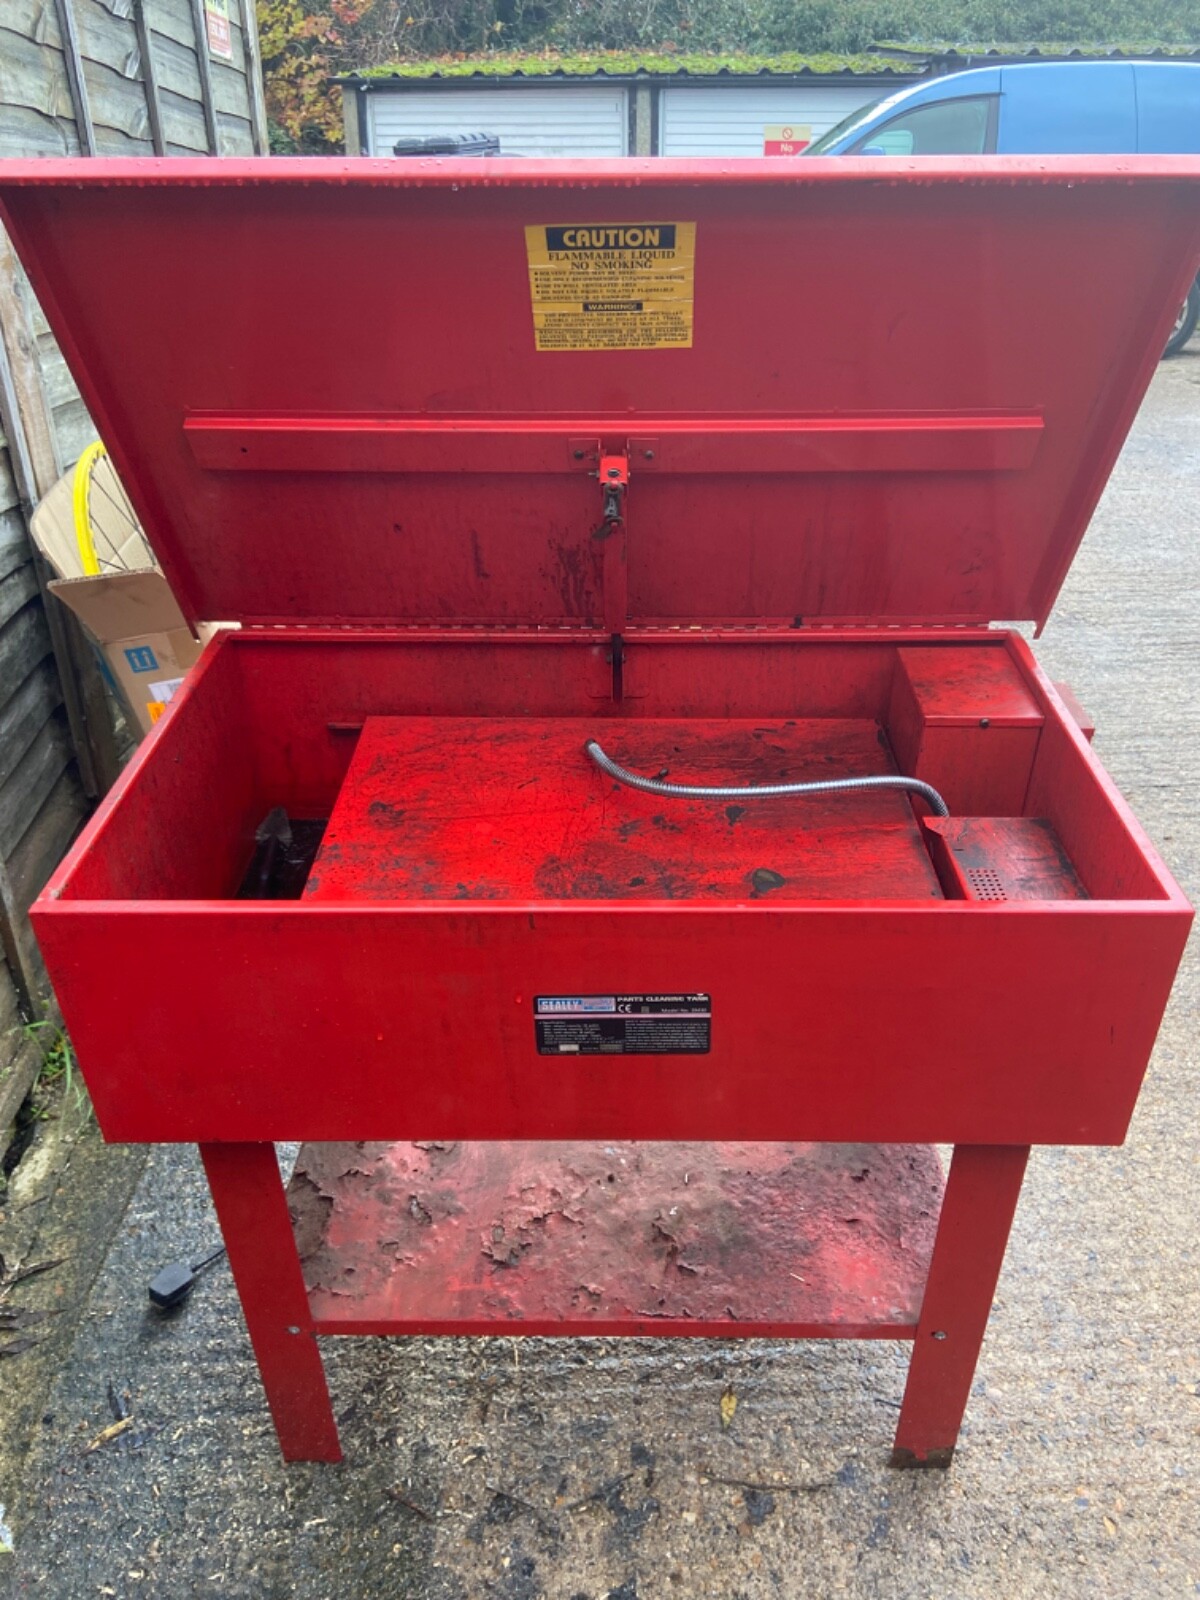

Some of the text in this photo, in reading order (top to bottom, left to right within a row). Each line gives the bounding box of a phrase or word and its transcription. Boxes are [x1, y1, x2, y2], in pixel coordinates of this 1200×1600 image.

[780, 143, 794, 152] No
[562, 228, 660, 248] CAUTION
[548, 250, 675, 262] FLAMMABLE LIQUID
[570, 260, 653, 270] NO SMOKING
